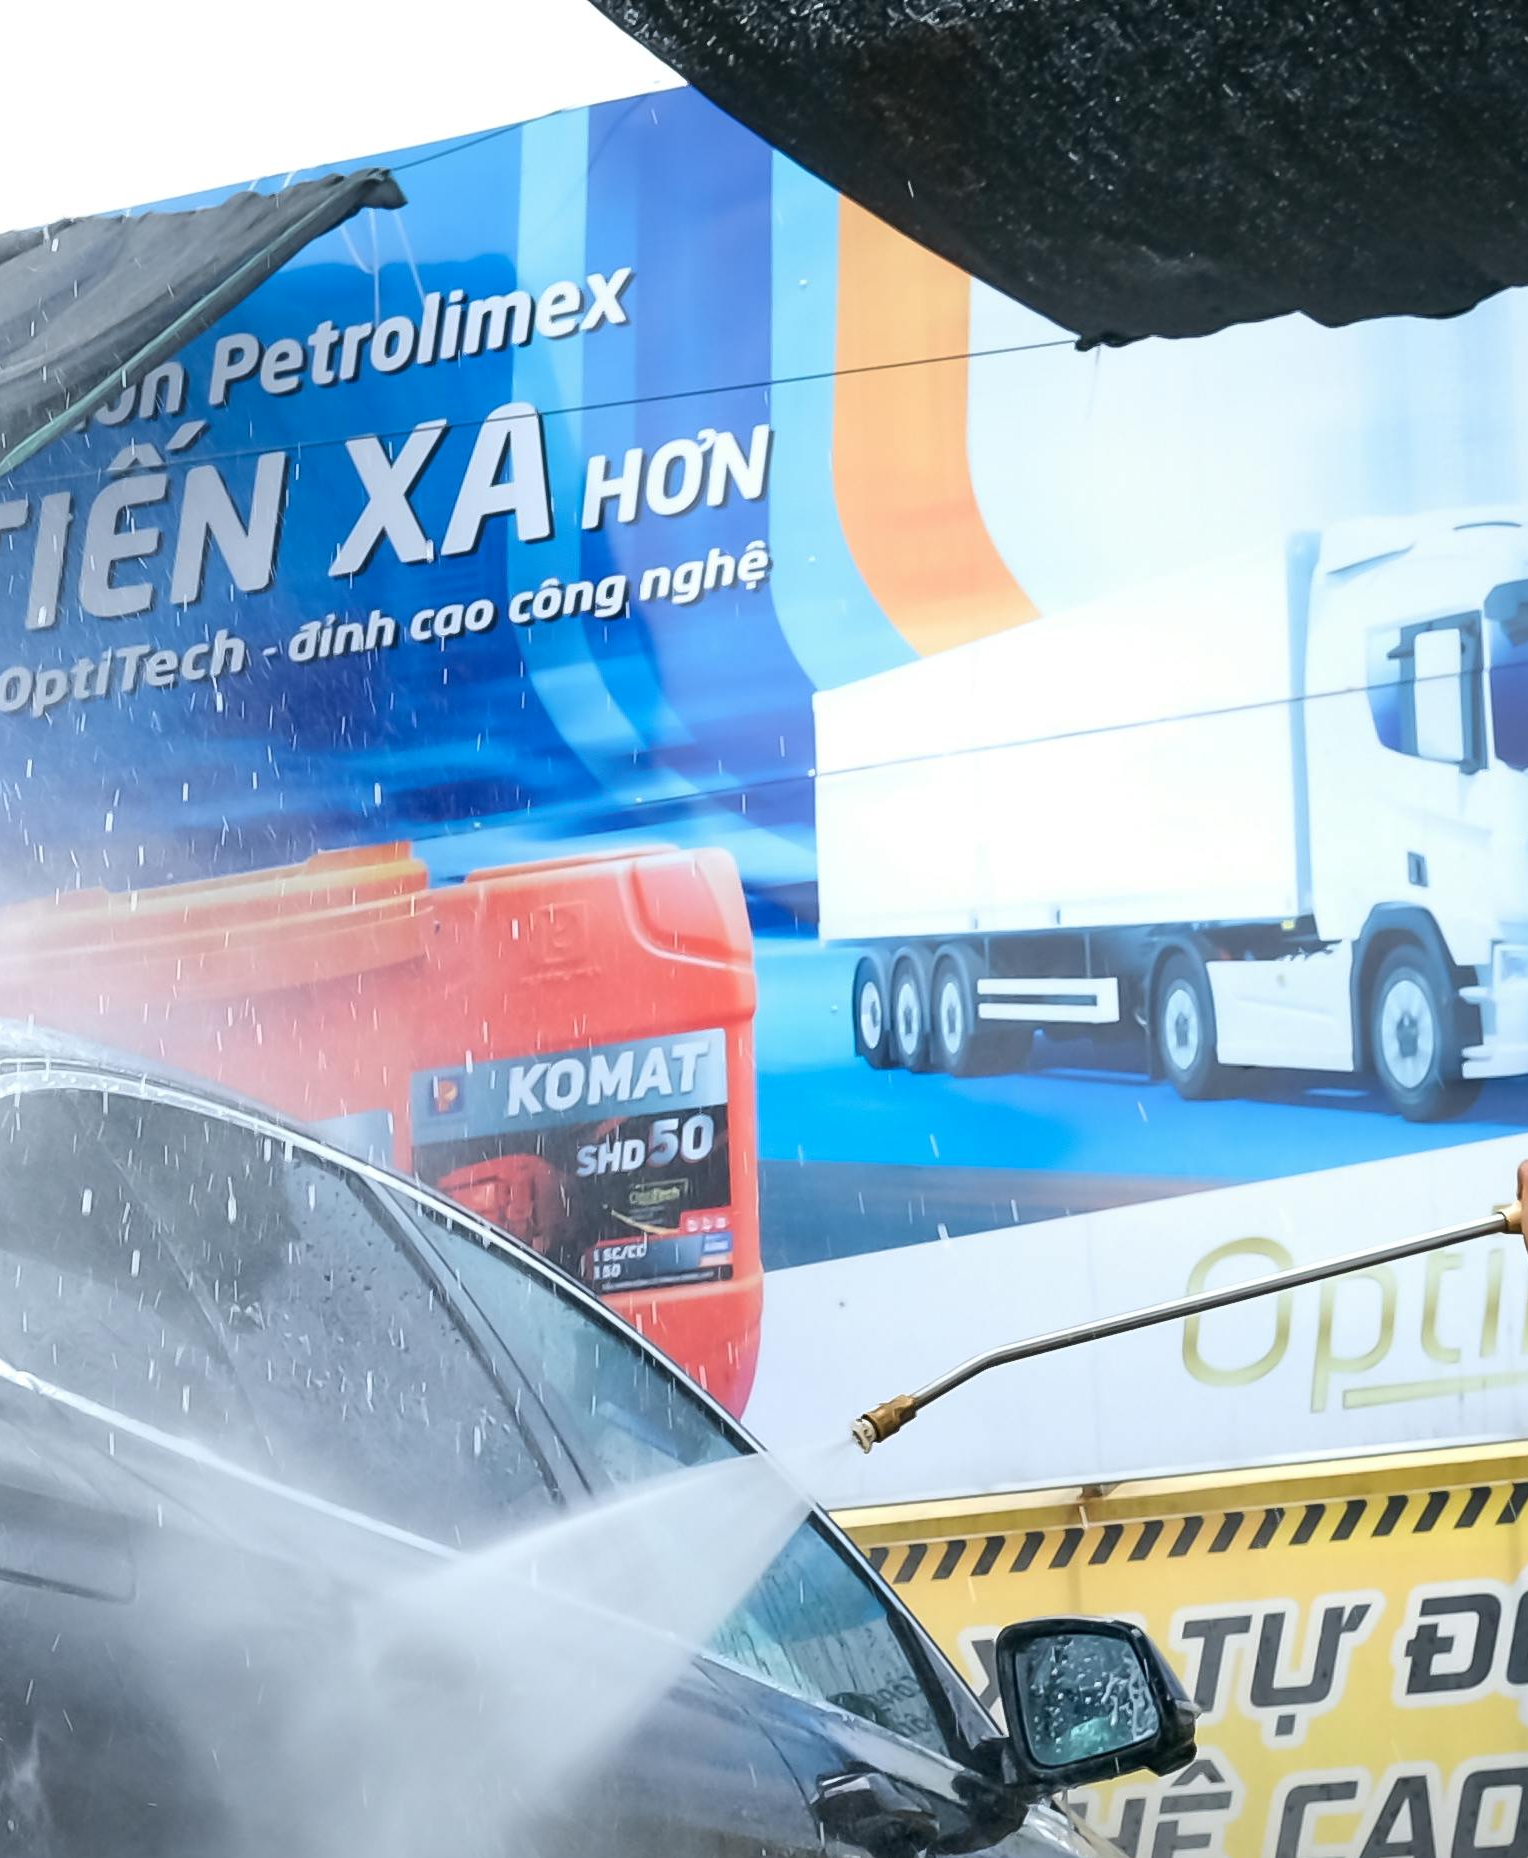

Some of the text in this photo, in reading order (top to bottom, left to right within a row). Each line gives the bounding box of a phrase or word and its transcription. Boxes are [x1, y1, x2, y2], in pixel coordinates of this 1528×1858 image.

[208, 266, 633, 407] Petrolimex
[328, 402, 554, 577] XA
[581, 423, 772, 530] HƠN
[410, 597, 493, 642] cao
[508, 567, 627, 630] công
[636, 540, 771, 604] nghệ
[505, 1040, 710, 1119] KOMAT
[575, 1113, 715, 1178] SHD 50
